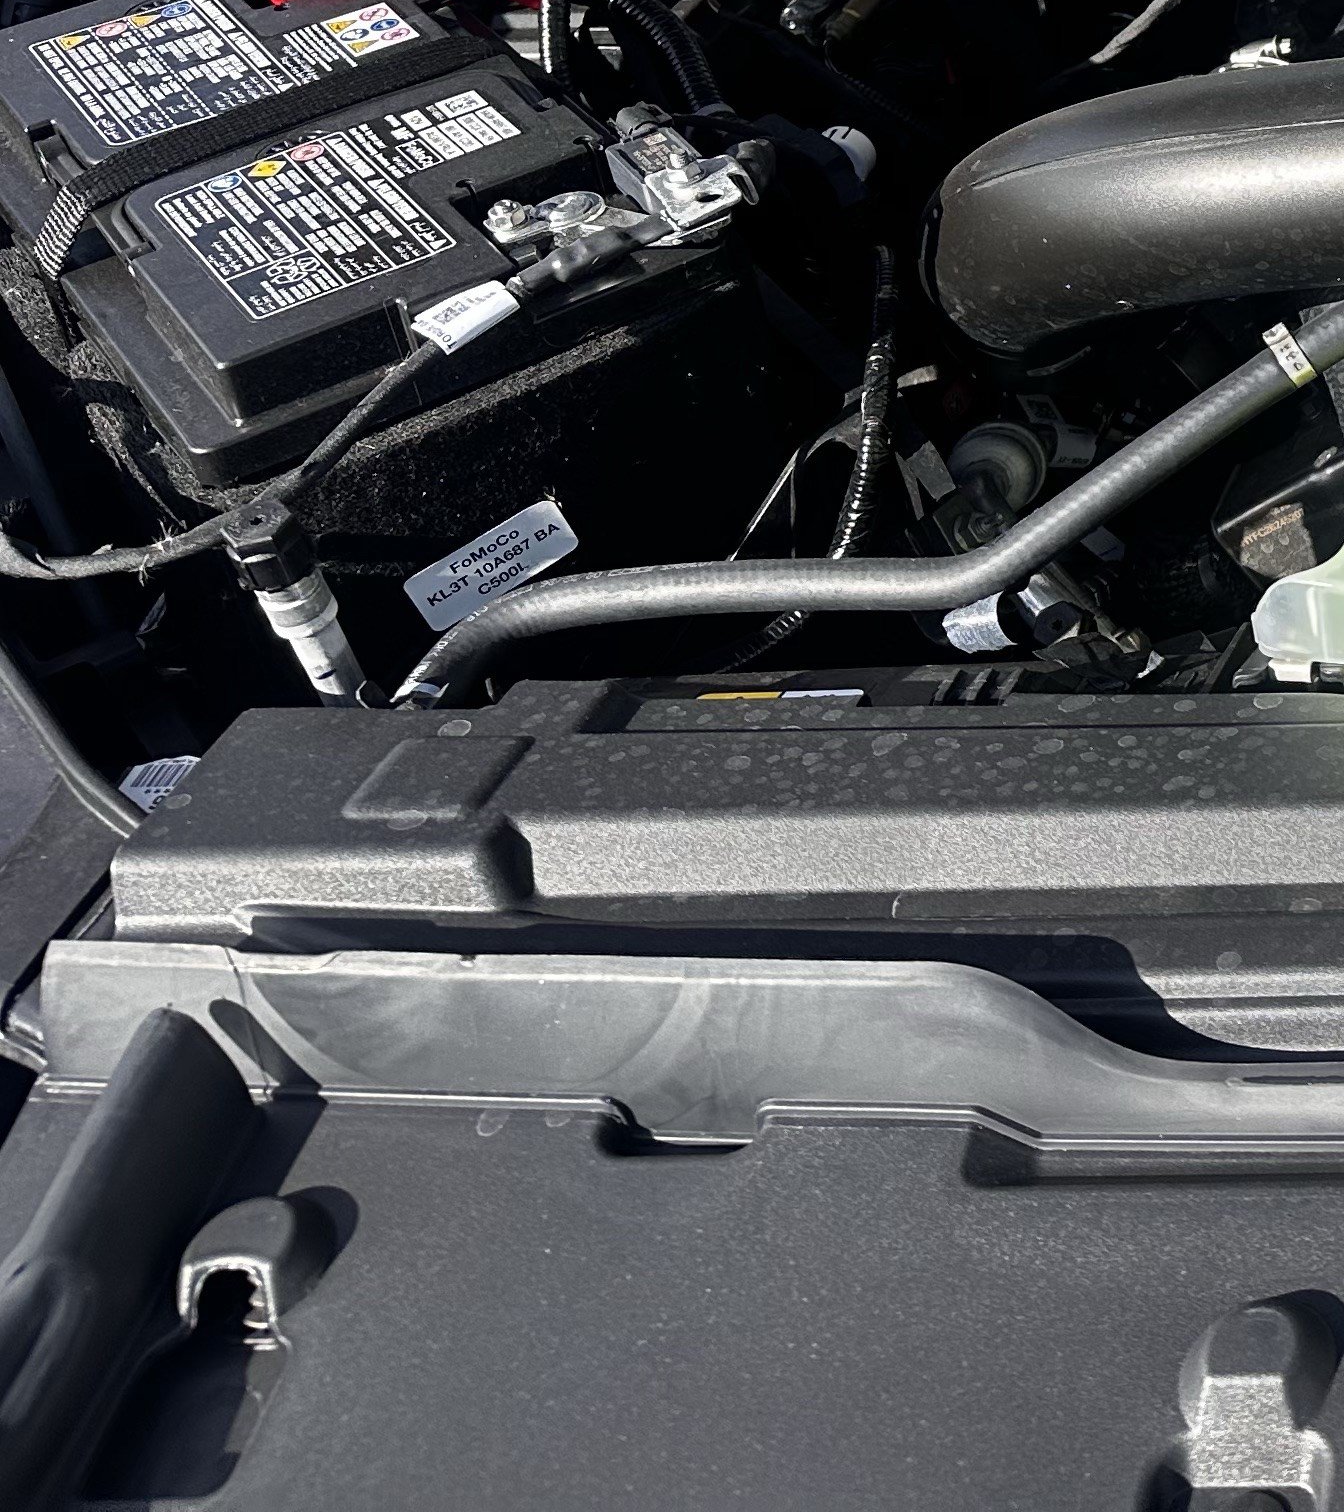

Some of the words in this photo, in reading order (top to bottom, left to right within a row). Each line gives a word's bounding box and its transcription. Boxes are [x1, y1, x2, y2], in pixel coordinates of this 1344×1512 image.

[426, 574, 470, 608] KL3T
[473, 537, 531, 579] 10A687
[533, 522, 561, 543] BA
[448, 529, 521, 575] FoMoCo
